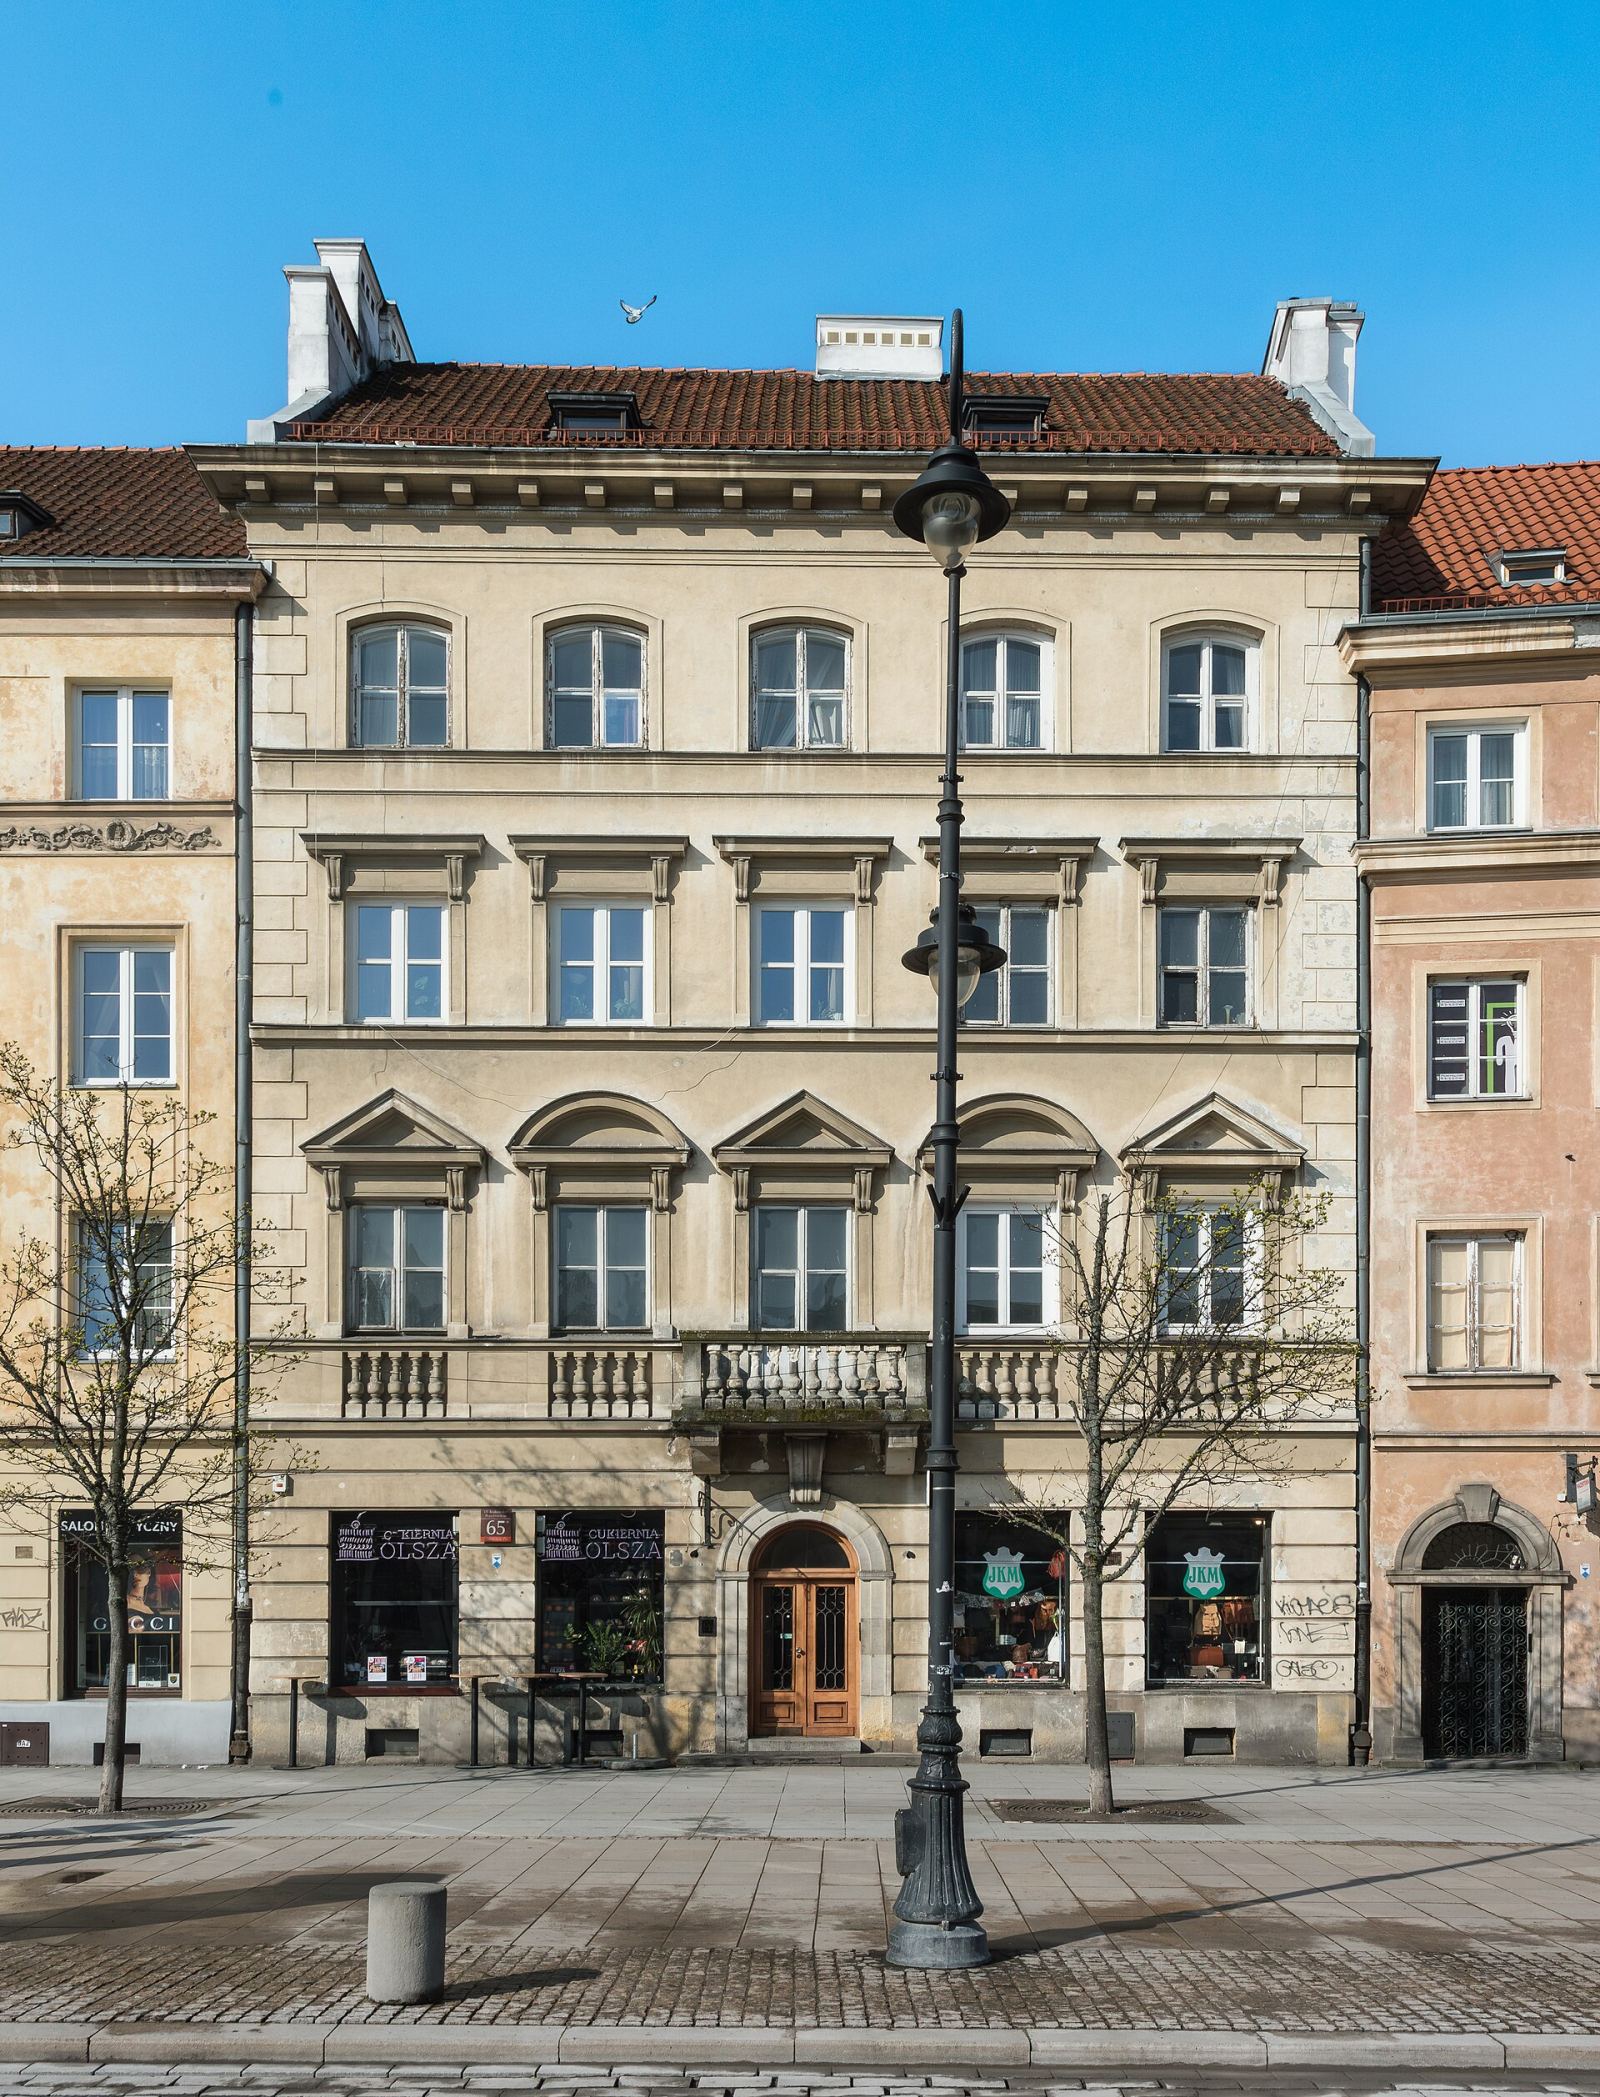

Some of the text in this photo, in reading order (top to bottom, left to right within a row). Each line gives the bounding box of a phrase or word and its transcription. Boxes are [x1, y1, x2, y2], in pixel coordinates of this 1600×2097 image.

[135, 1521, 178, 1532] YCZNY
[486, 1519, 506, 1536] 65
[588, 1528, 661, 1539] CUKIERNIA
[380, 1541, 457, 1560] OLSZA
[585, 1541, 663, 1560] OLSZA
[989, 1566, 1020, 1583] JKM
[1189, 1566, 1220, 1584] JKM
[93, 1617, 174, 1630] GCCI
